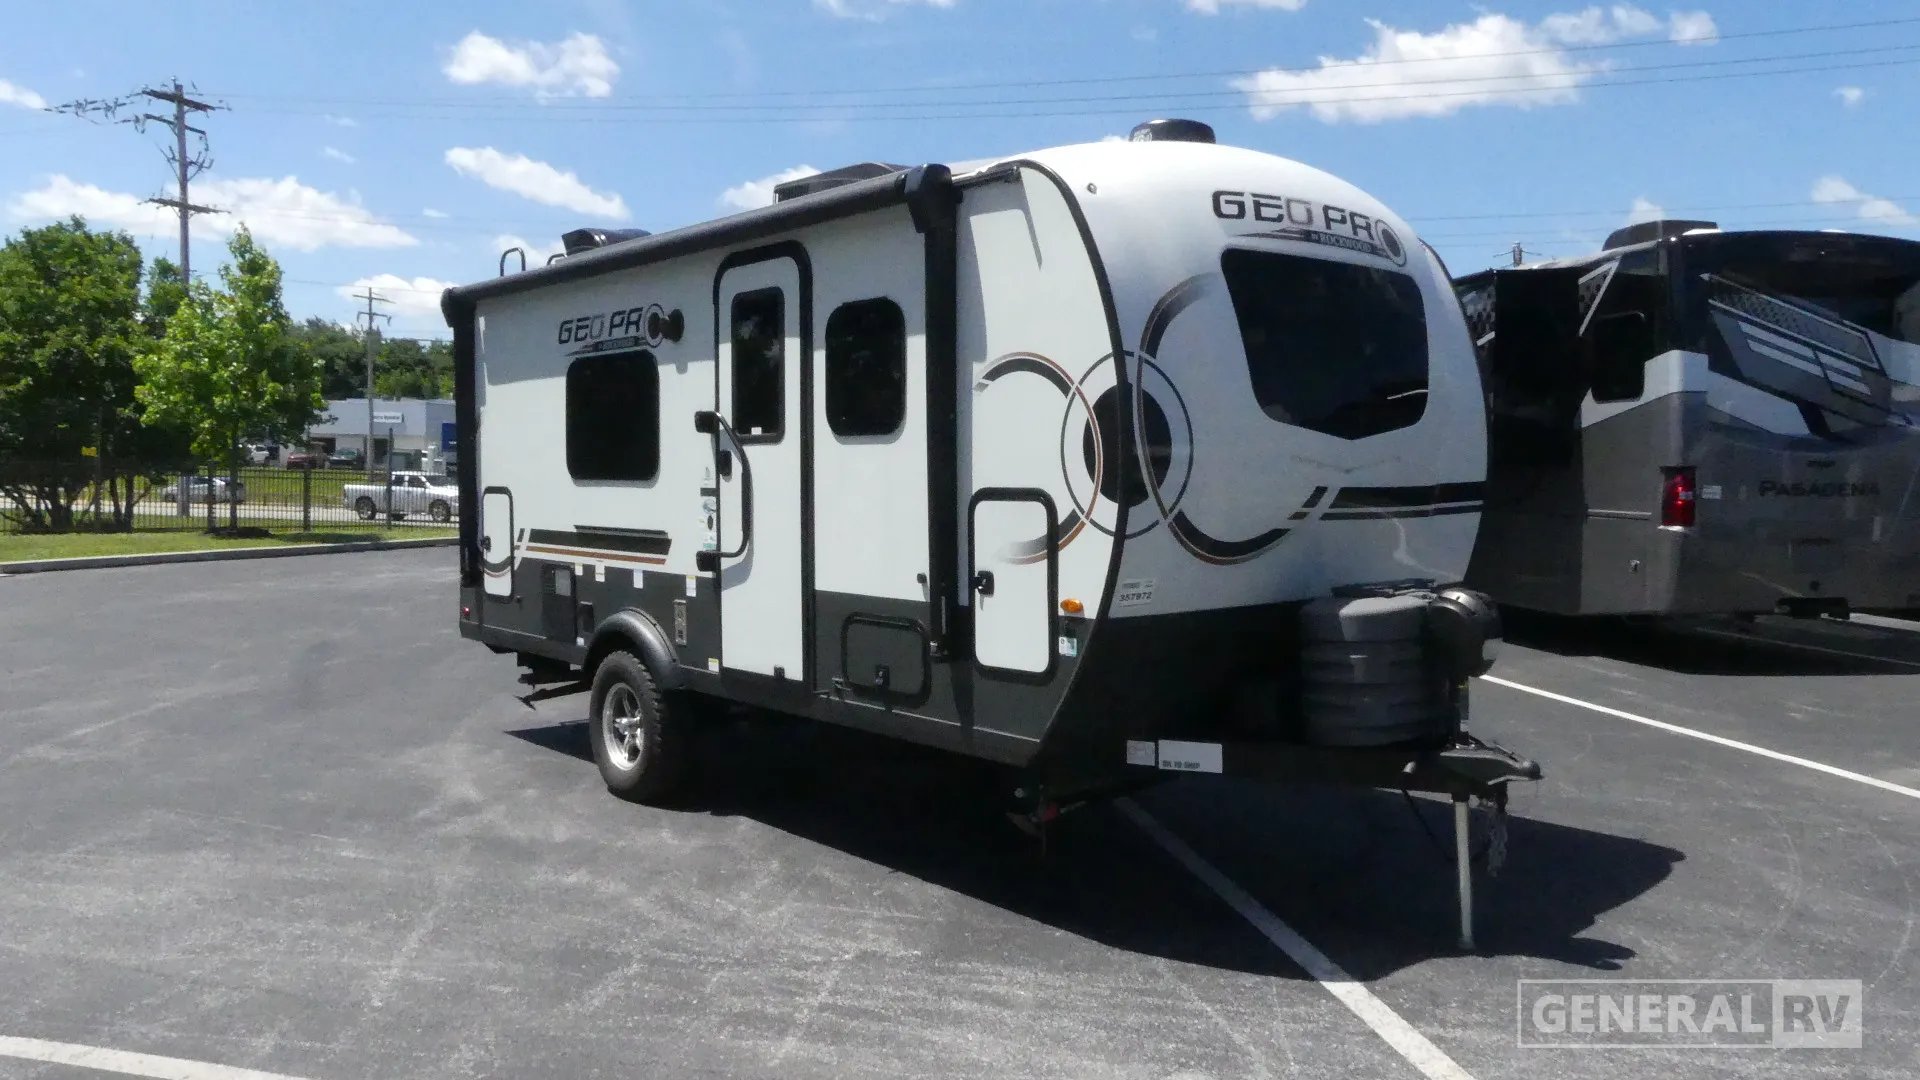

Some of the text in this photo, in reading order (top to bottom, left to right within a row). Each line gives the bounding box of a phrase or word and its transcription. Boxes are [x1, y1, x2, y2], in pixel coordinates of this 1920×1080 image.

[1212, 190, 1407, 267] GEO PRO
[1320, 232, 1372, 253] ROCKWOOD
[558, 313, 604, 344] GEO
[1758, 480, 1881, 497] PASADENA
